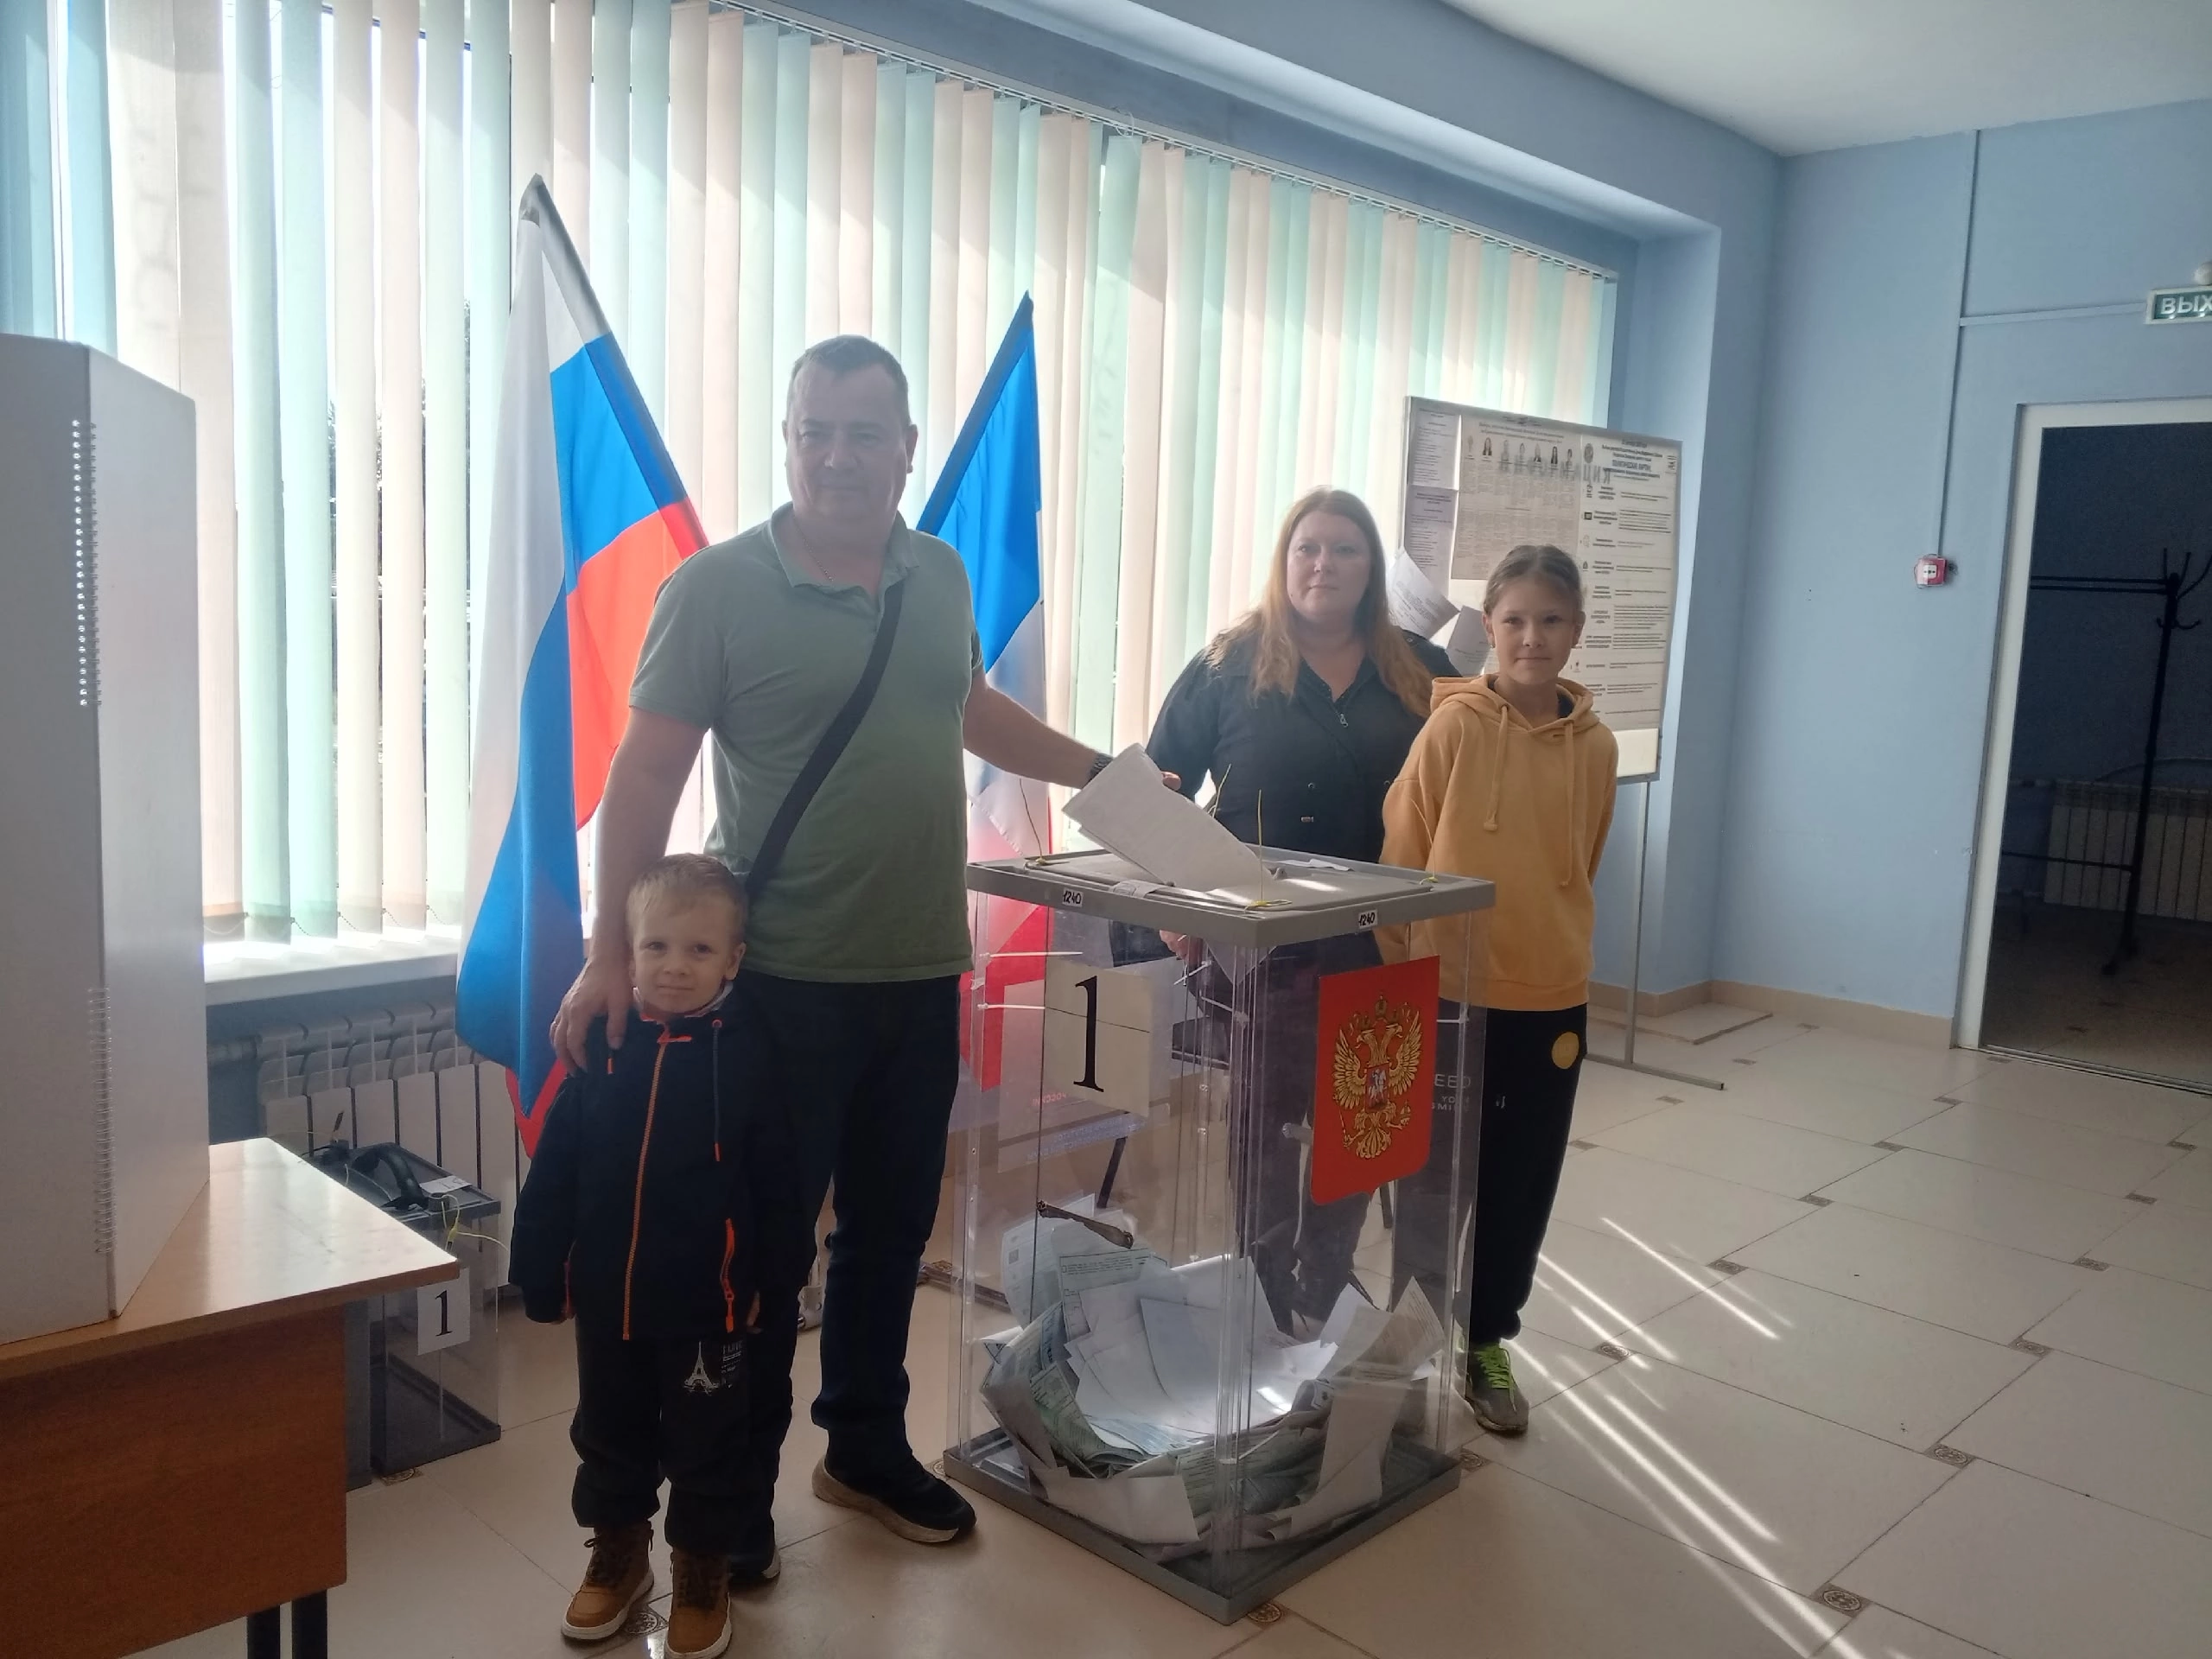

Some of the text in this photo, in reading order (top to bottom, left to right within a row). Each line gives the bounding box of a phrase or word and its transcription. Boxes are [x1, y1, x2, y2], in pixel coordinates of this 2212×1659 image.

[1064, 890, 1082, 904] 1240
[1358, 912, 1375, 926] 1240
[1073, 975, 1104, 1093] 1
[435, 1289, 454, 1337] 1
